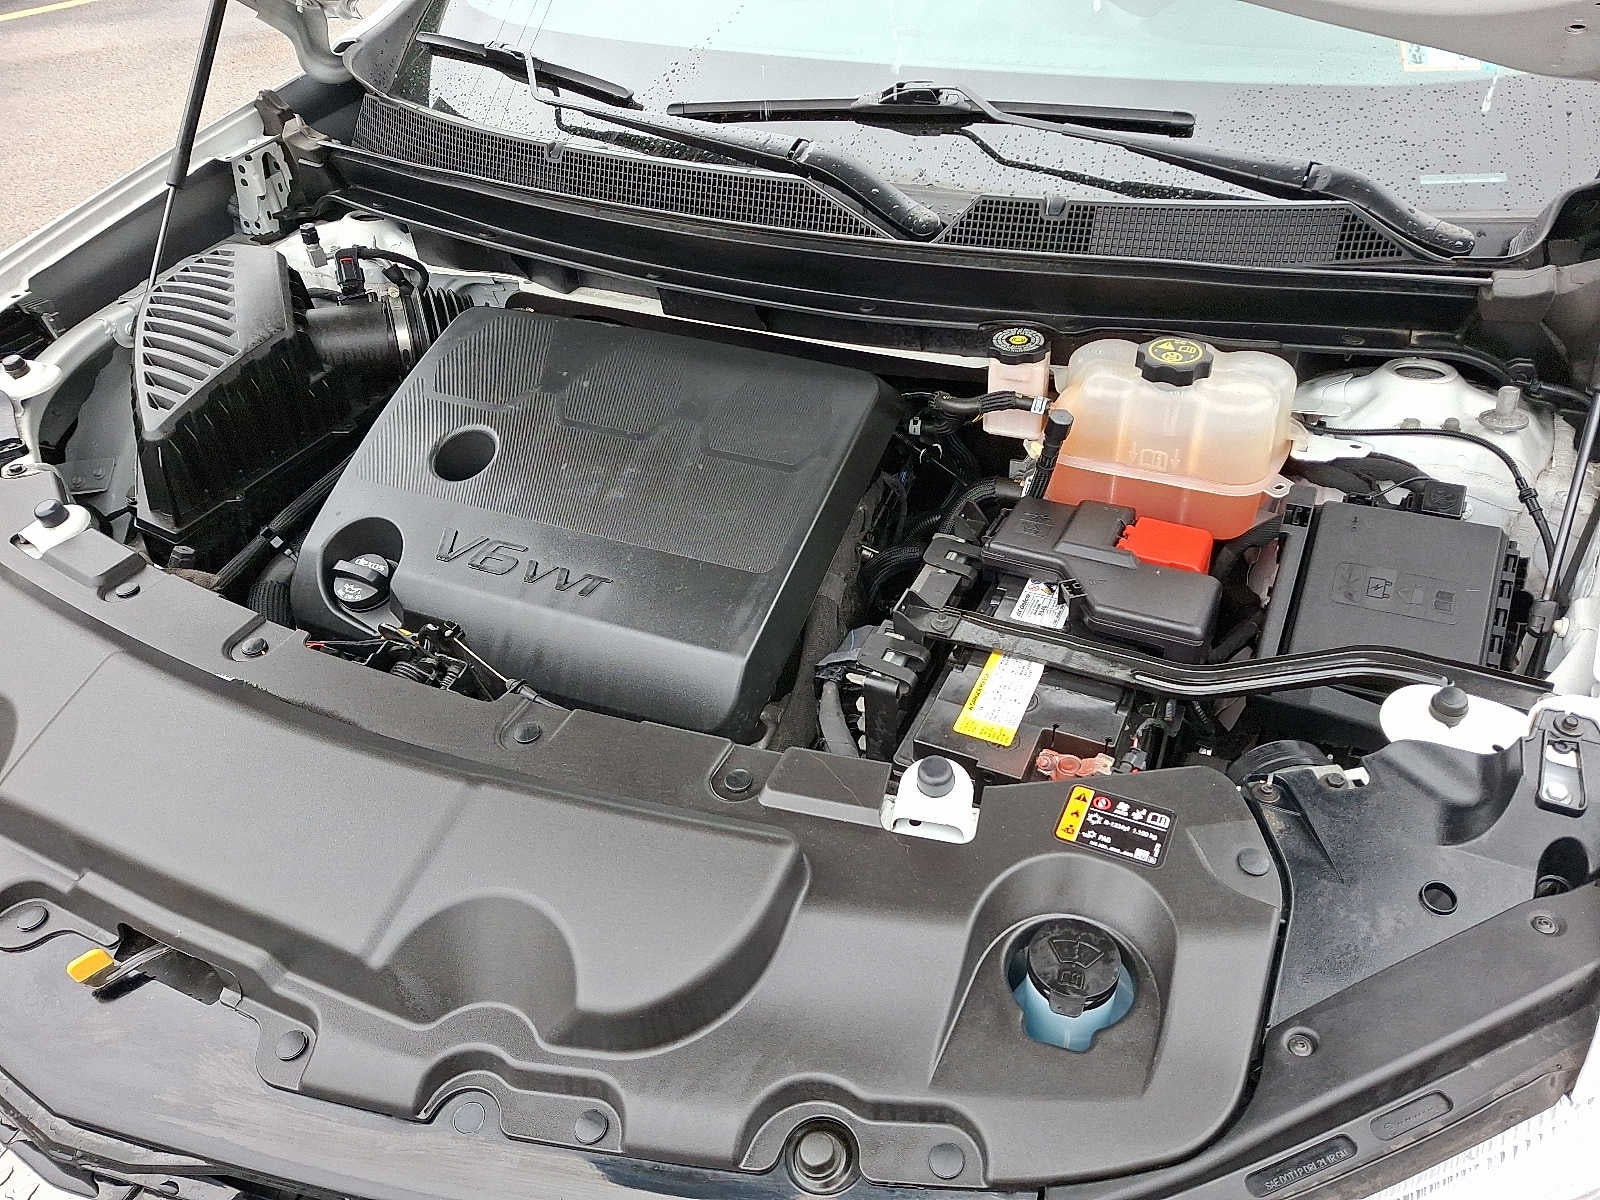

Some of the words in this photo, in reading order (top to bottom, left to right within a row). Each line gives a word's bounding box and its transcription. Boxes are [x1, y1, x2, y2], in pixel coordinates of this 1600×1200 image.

[435, 528, 529, 576] V6
[523, 560, 614, 598] VVT
[1264, 1178, 1280, 1190] SAE
